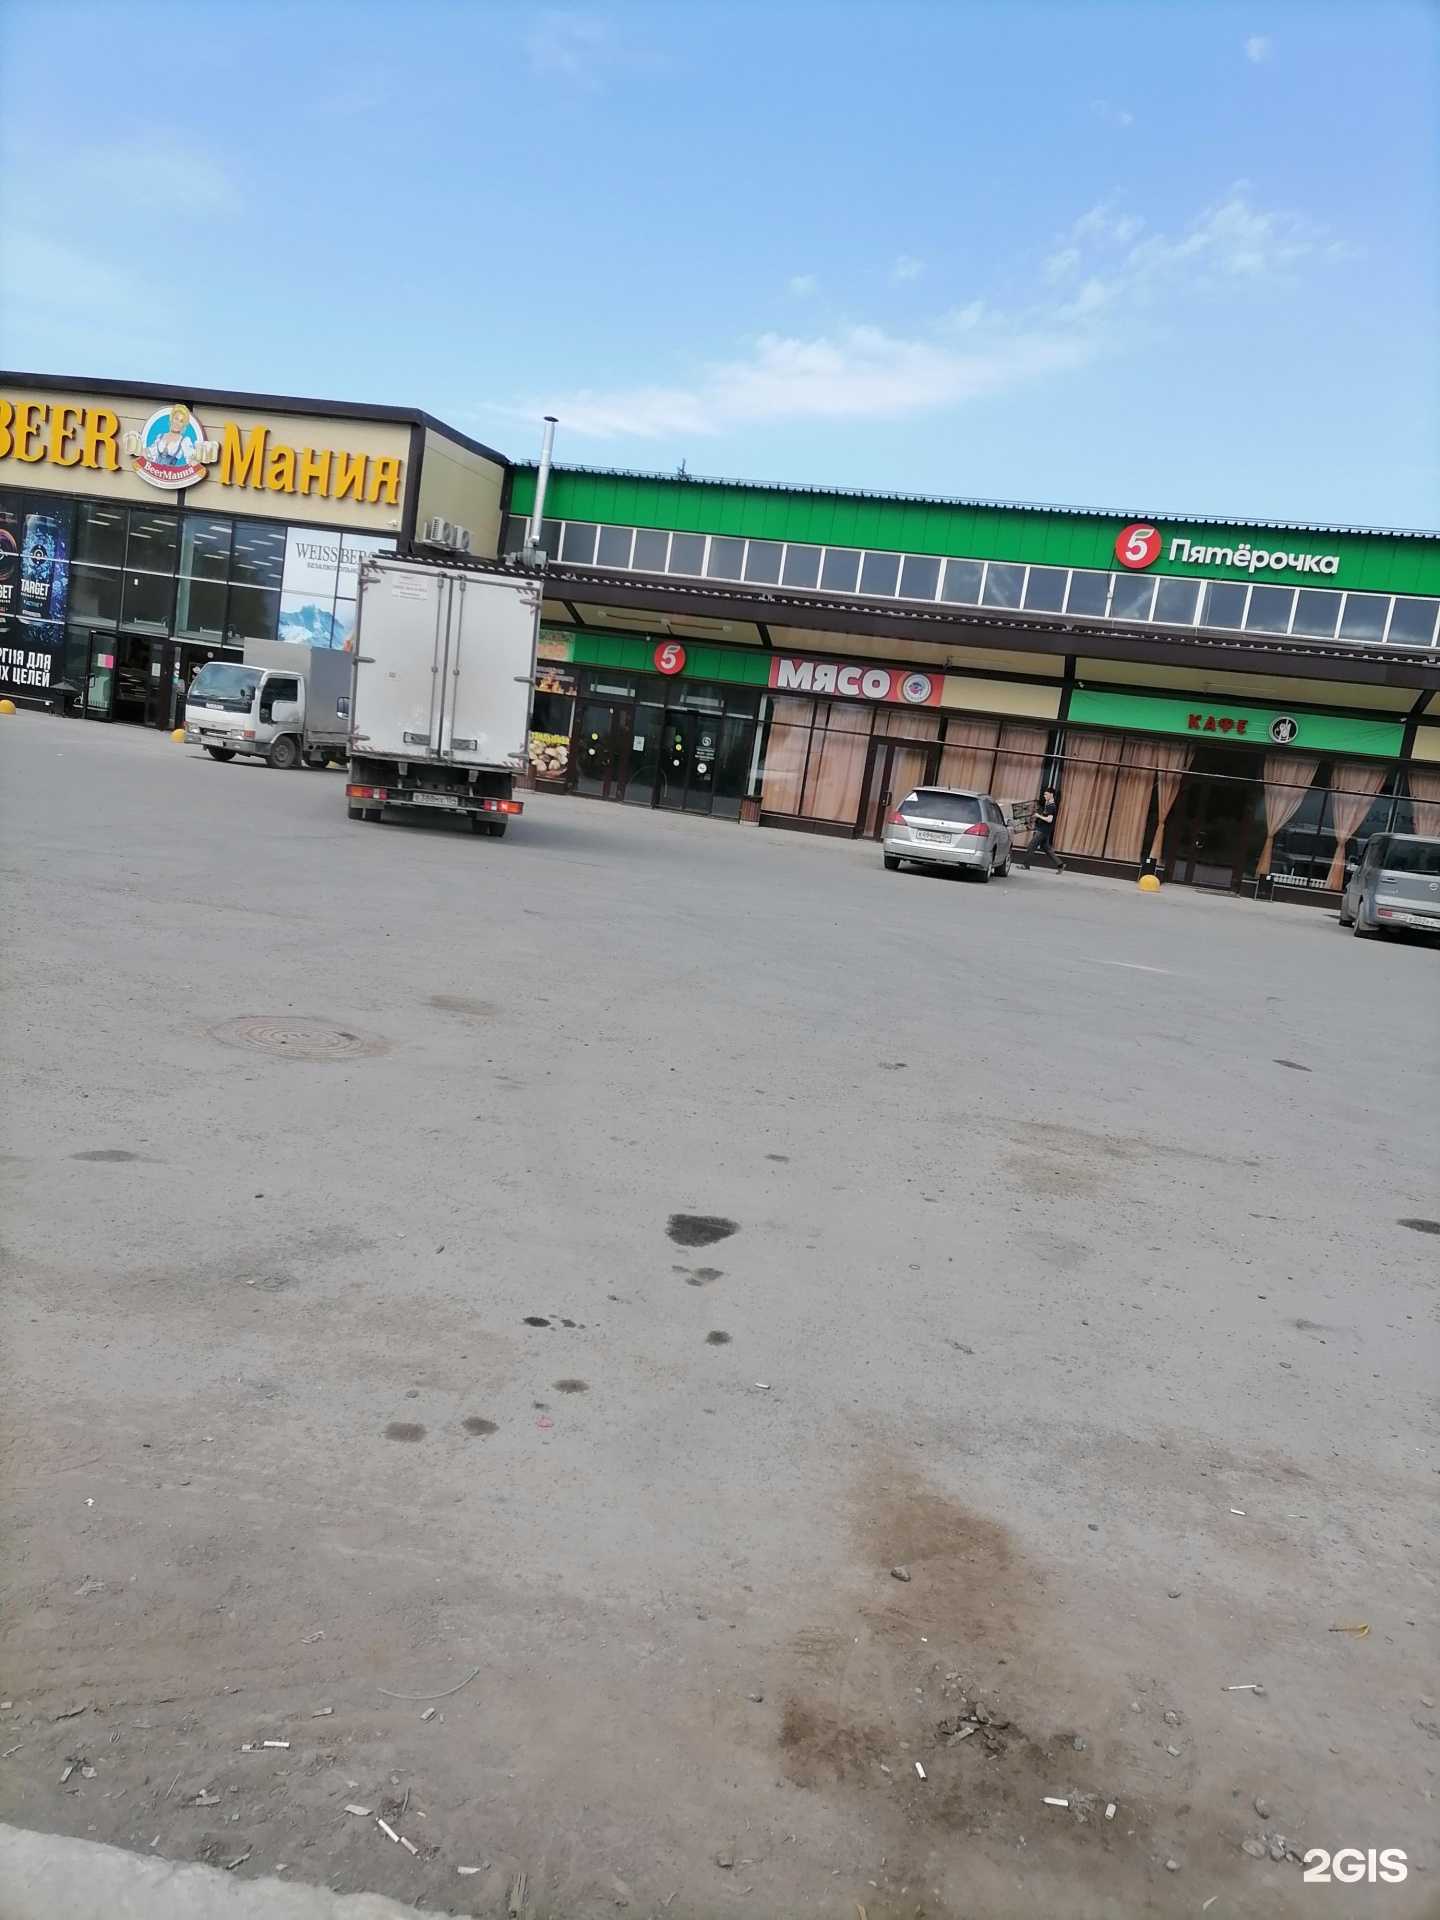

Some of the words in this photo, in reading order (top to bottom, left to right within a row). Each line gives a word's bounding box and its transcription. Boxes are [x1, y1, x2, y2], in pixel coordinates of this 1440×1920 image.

[220, 420, 401, 505] Мания
[1125, 528, 1154, 561] 5
[1169, 538, 1340, 575] Пятёрочка
[20, 578, 50, 598] TARGET
[26, 651, 52, 671] ДЛЯ
[660, 645, 681, 670] 5
[12, 667, 51, 688] ЦЕЛЕЙ
[777, 658, 891, 699] МЯСО
[1187, 713, 1249, 735] КАФЕ
